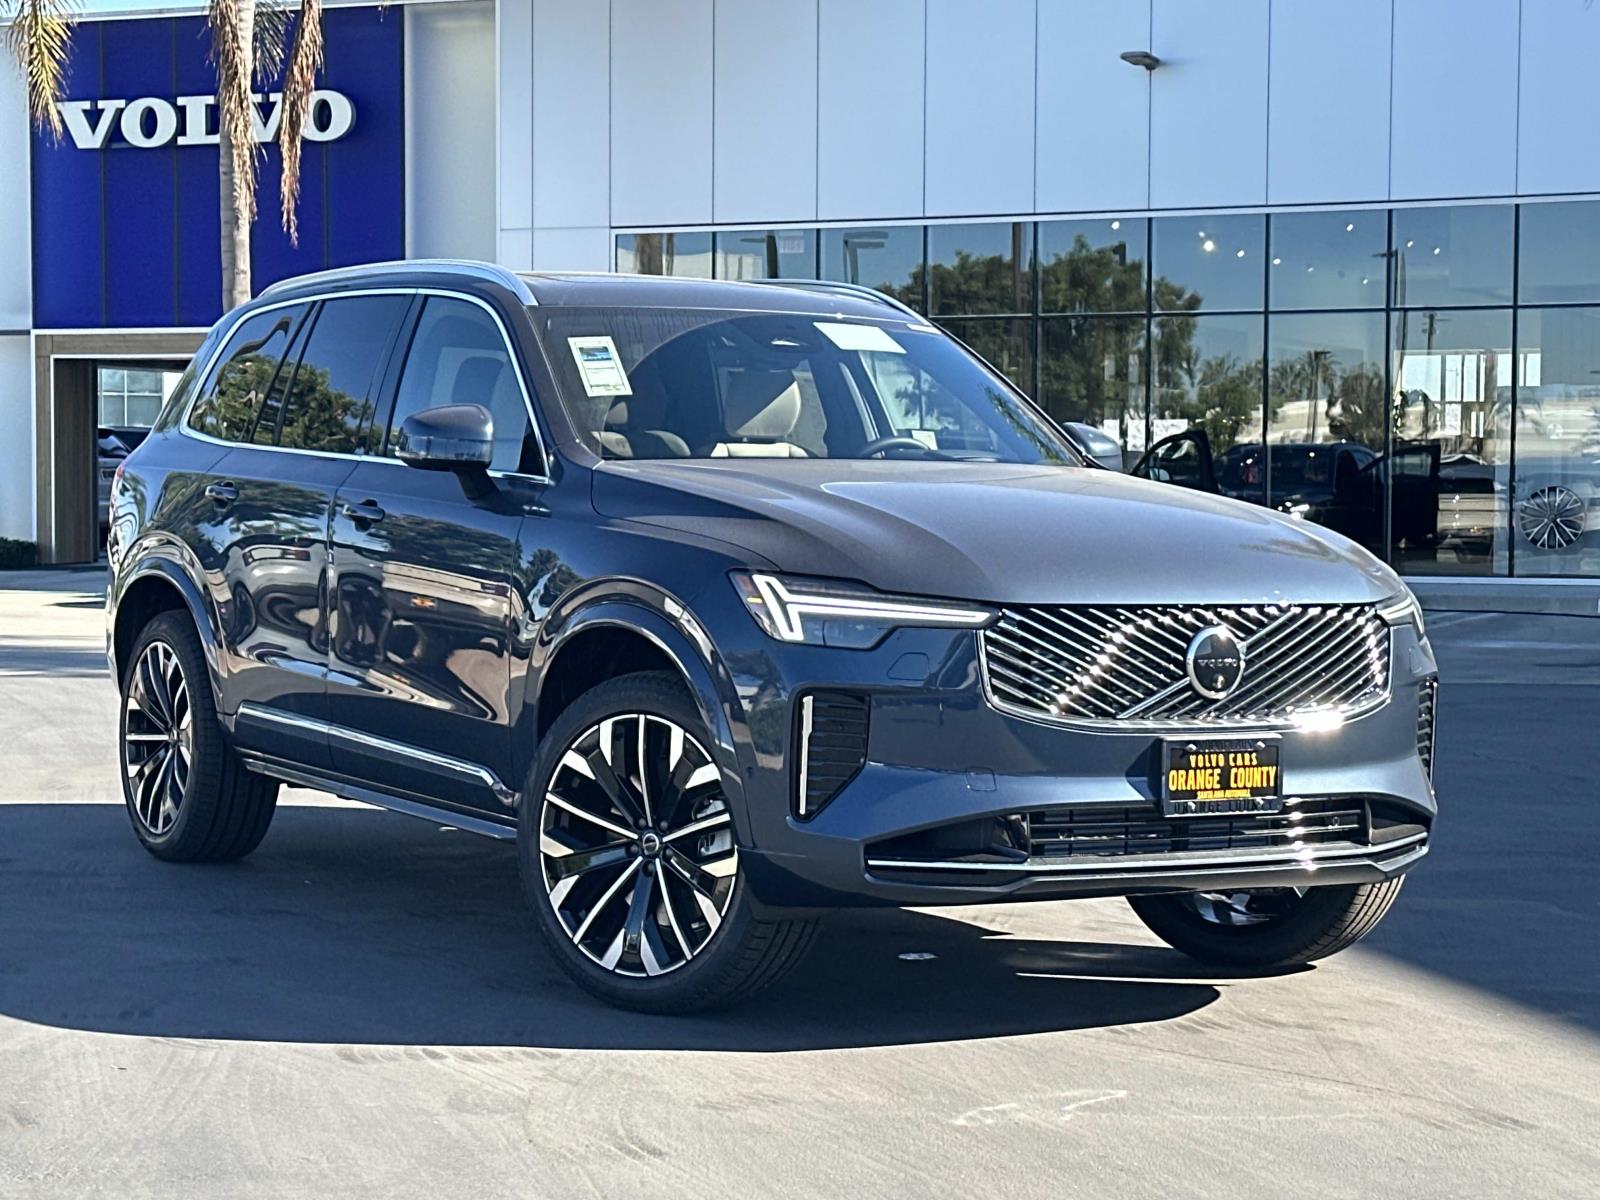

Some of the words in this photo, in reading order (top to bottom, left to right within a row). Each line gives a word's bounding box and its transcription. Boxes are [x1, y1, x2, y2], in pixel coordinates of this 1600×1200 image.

[58, 90, 356, 149] VOLVO
[1190, 753, 1225, 768] VOLVO
[1229, 752, 1258, 766] CARS
[1168, 768, 1221, 791] ORANGE
[1230, 766, 1276, 788] COUNTY
